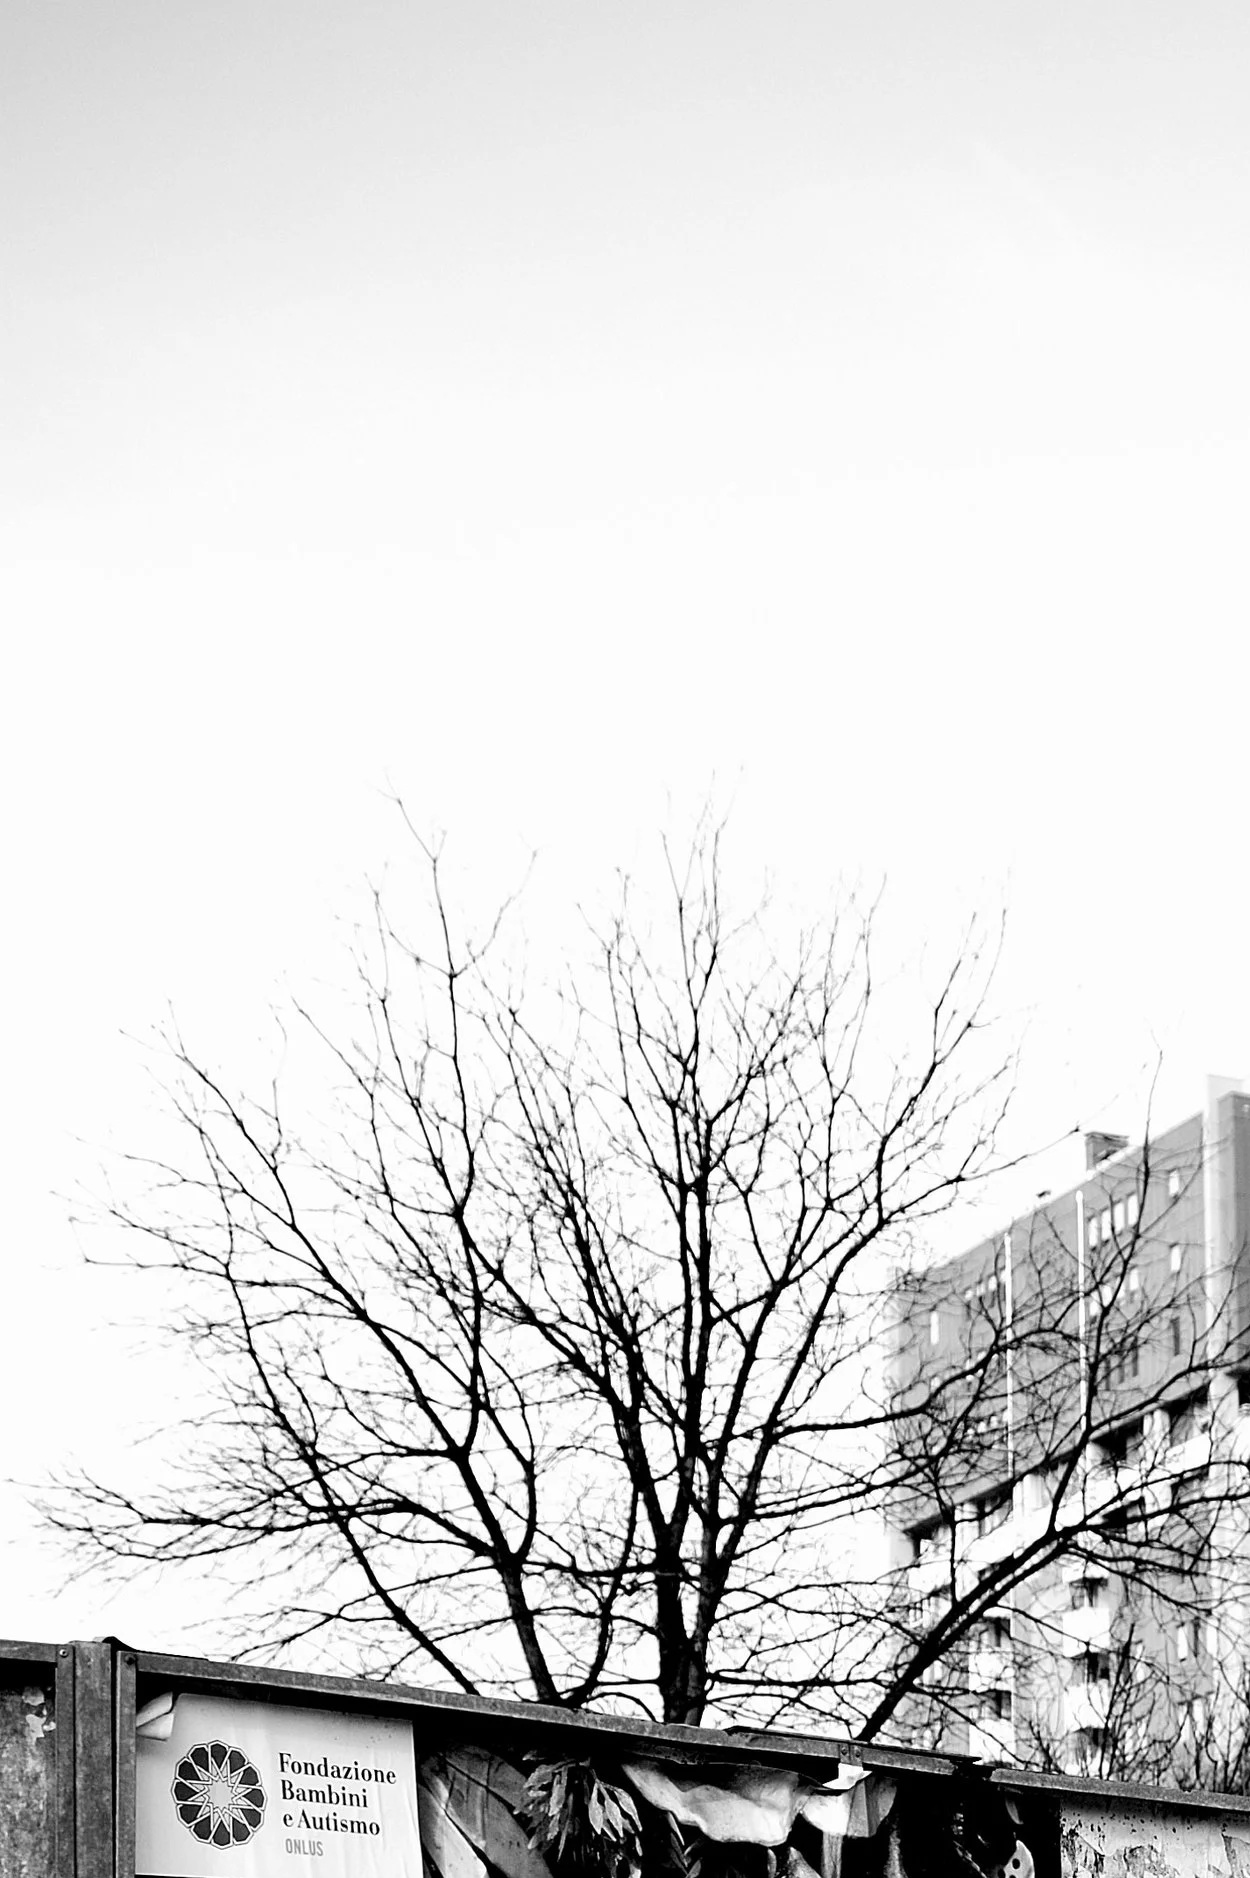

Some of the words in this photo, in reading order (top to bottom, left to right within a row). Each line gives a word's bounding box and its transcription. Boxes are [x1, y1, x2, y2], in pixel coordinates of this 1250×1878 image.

[278, 1752, 397, 1785] Fondazione
[280, 1780, 369, 1809] Bambini
[283, 1814, 293, 1829] e
[296, 1808, 381, 1838] Autismo
[285, 1838, 324, 1857] ONLUS
